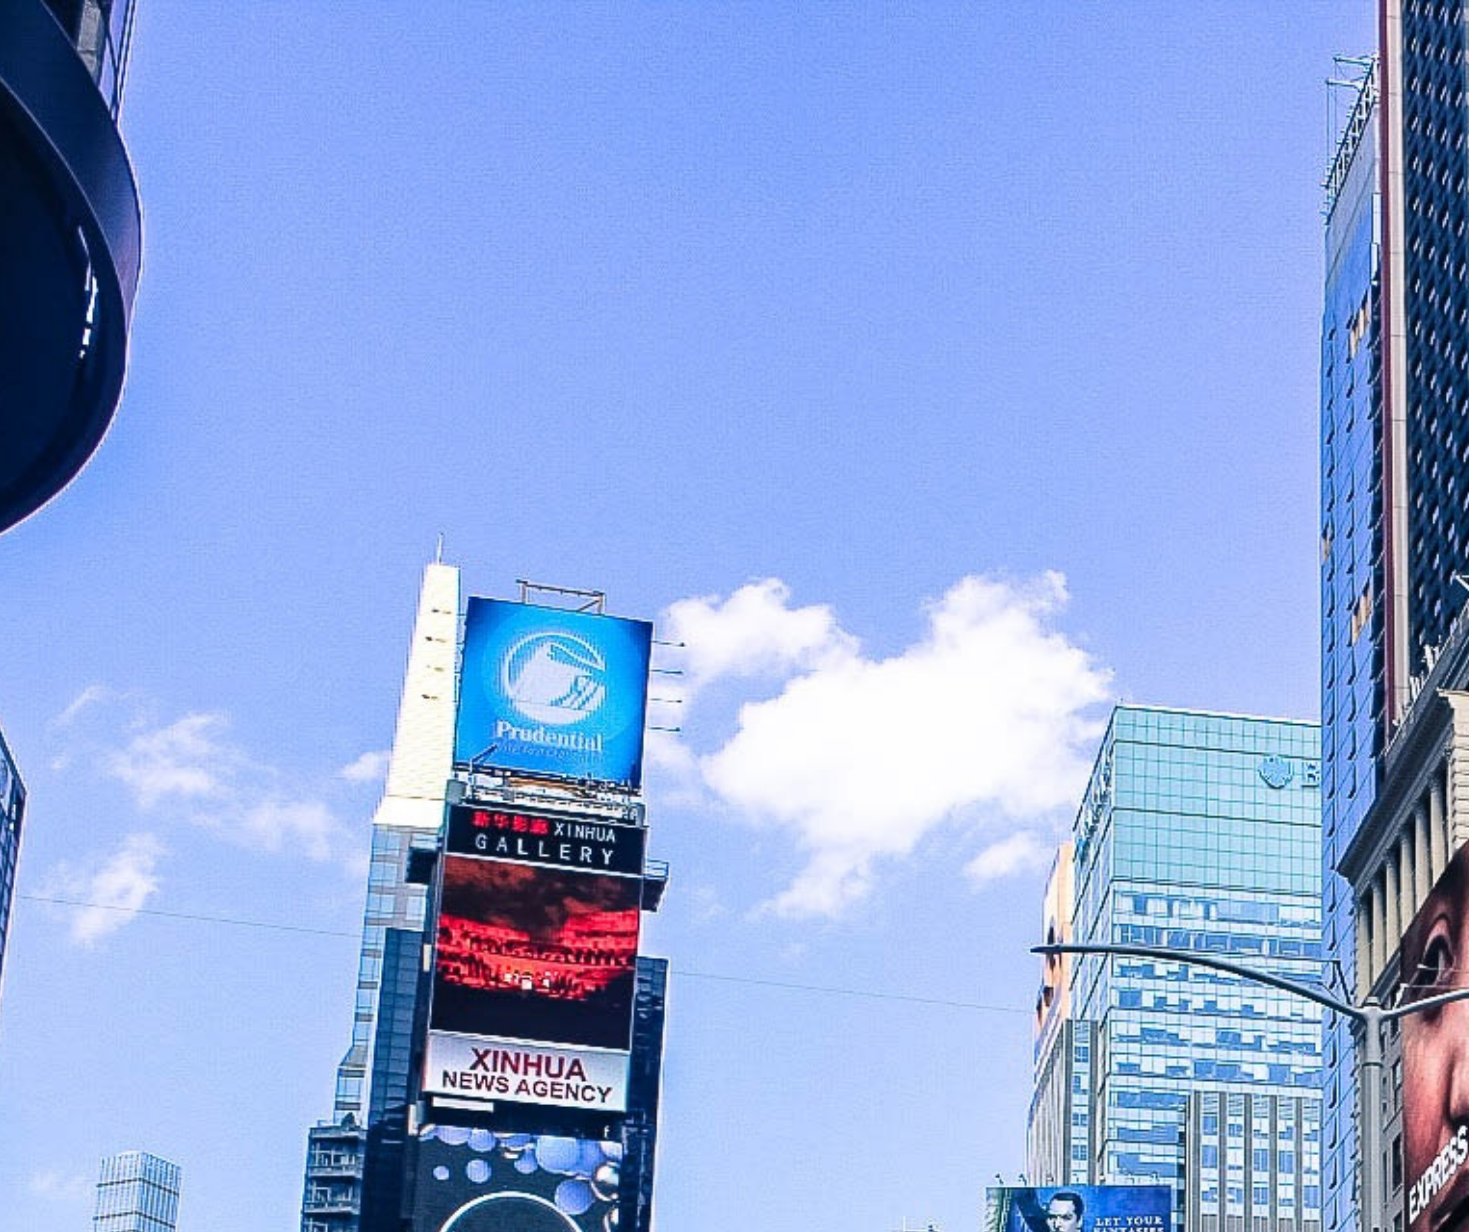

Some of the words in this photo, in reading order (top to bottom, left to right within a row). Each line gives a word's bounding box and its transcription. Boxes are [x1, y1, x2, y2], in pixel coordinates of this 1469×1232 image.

[496, 719, 602, 751] Prudential
[554, 821, 617, 843] XINHUA
[475, 833, 614, 866] GALLERY
[469, 1048, 588, 1082] XINHUA
[442, 1070, 510, 1093] NEWS
[514, 1078, 613, 1103] AGENCY
[1408, 1124, 1469, 1225] EXPRESS
[1095, 1217, 1119, 1227] LET
[1124, 1215, 1163, 1226] YOUR
